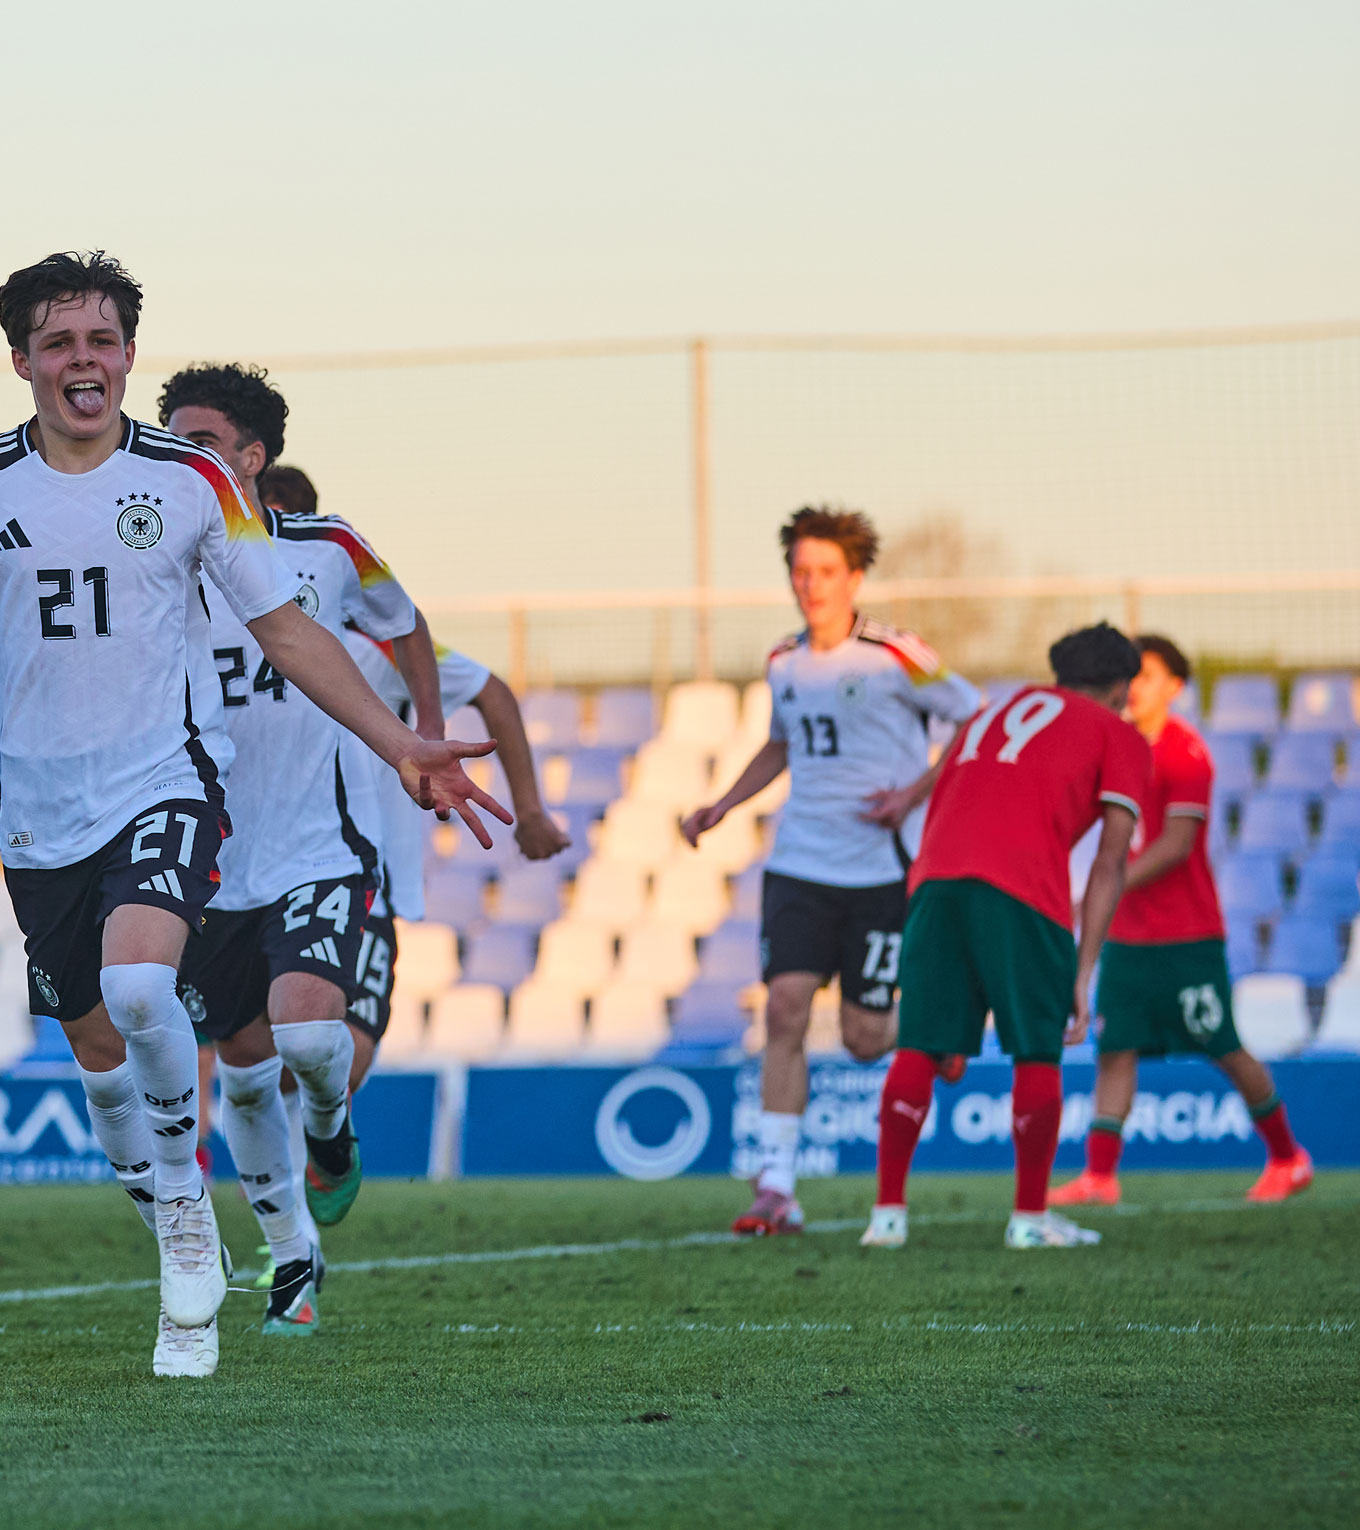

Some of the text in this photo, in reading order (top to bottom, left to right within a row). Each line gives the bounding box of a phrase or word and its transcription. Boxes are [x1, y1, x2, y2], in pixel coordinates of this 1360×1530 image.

[37, 566, 111, 640] 21
[213, 646, 288, 707] 24
[800, 714, 839, 757] 13
[956, 690, 1065, 765] 19
[131, 810, 198, 869] 21
[283, 883, 351, 936] 24
[356, 929, 391, 999] 15
[862, 929, 903, 983] 13
[144, 1087, 195, 1108] DFB
